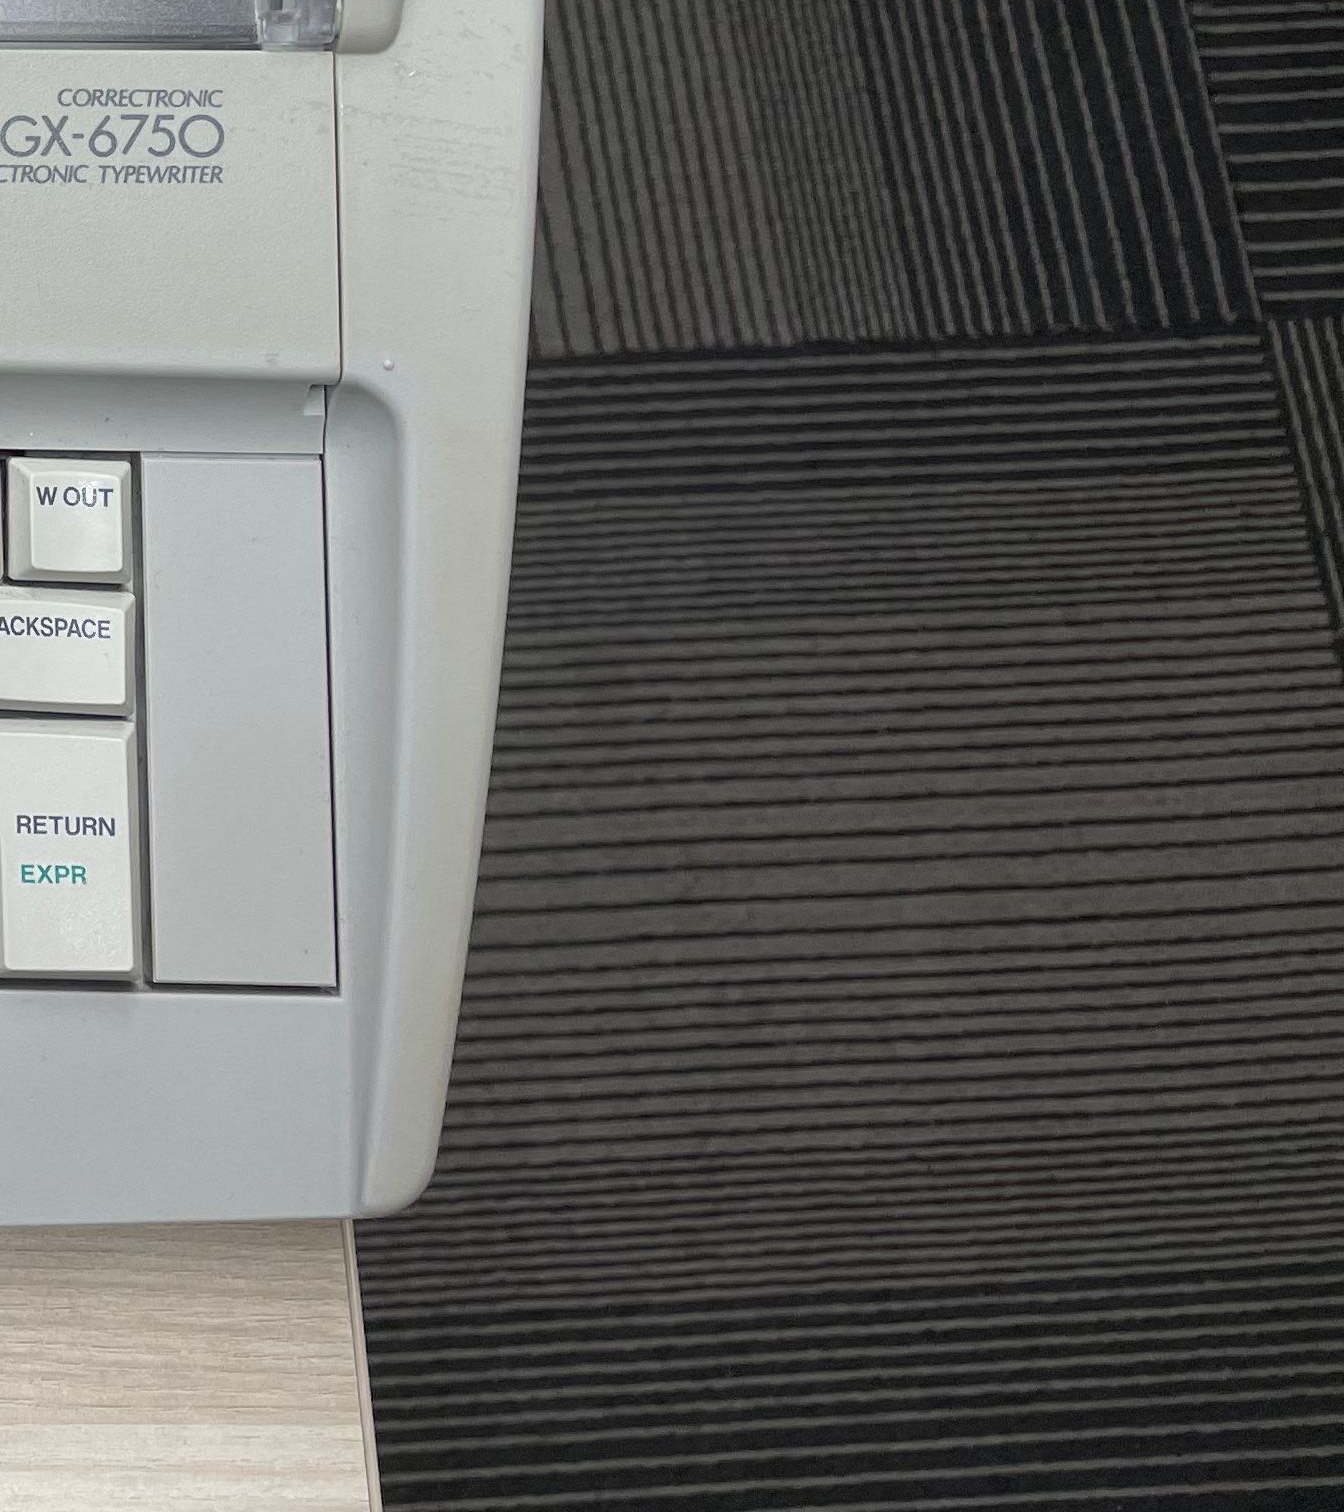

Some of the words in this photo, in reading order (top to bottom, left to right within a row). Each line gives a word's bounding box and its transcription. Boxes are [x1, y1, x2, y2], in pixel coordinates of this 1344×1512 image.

[57, 88, 224, 108] CORRECTRONIC
[0, 113, 225, 159] GX-6750
[98, 164, 223, 184] TYPEWRITER
[35, 486, 58, 506] W
[62, 486, 114, 508] OUT
[16, 814, 116, 837] RETURN
[20, 864, 87, 885] EXPR
